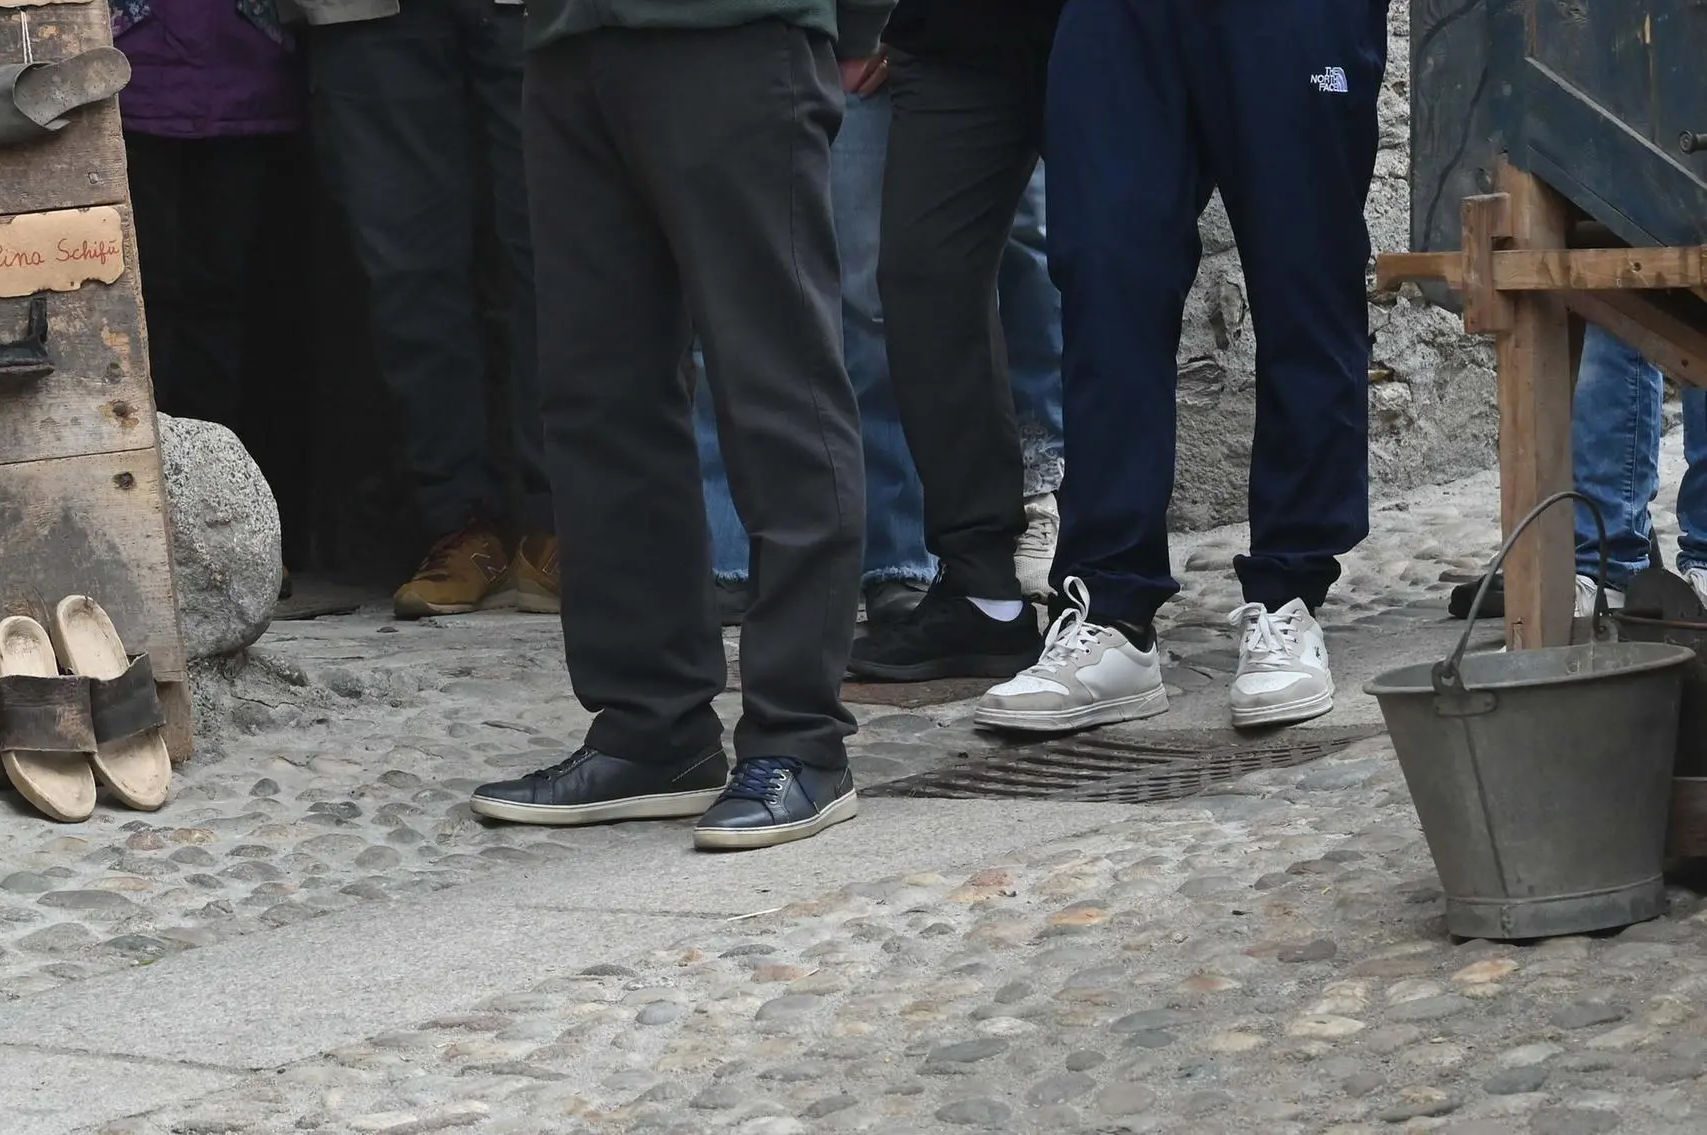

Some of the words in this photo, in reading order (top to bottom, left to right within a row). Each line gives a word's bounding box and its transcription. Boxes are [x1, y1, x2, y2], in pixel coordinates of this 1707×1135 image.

[1325, 67, 1338, 75] THE
[1311, 75, 1338, 83] NORTH
[1319, 83, 1339, 92] FACE
